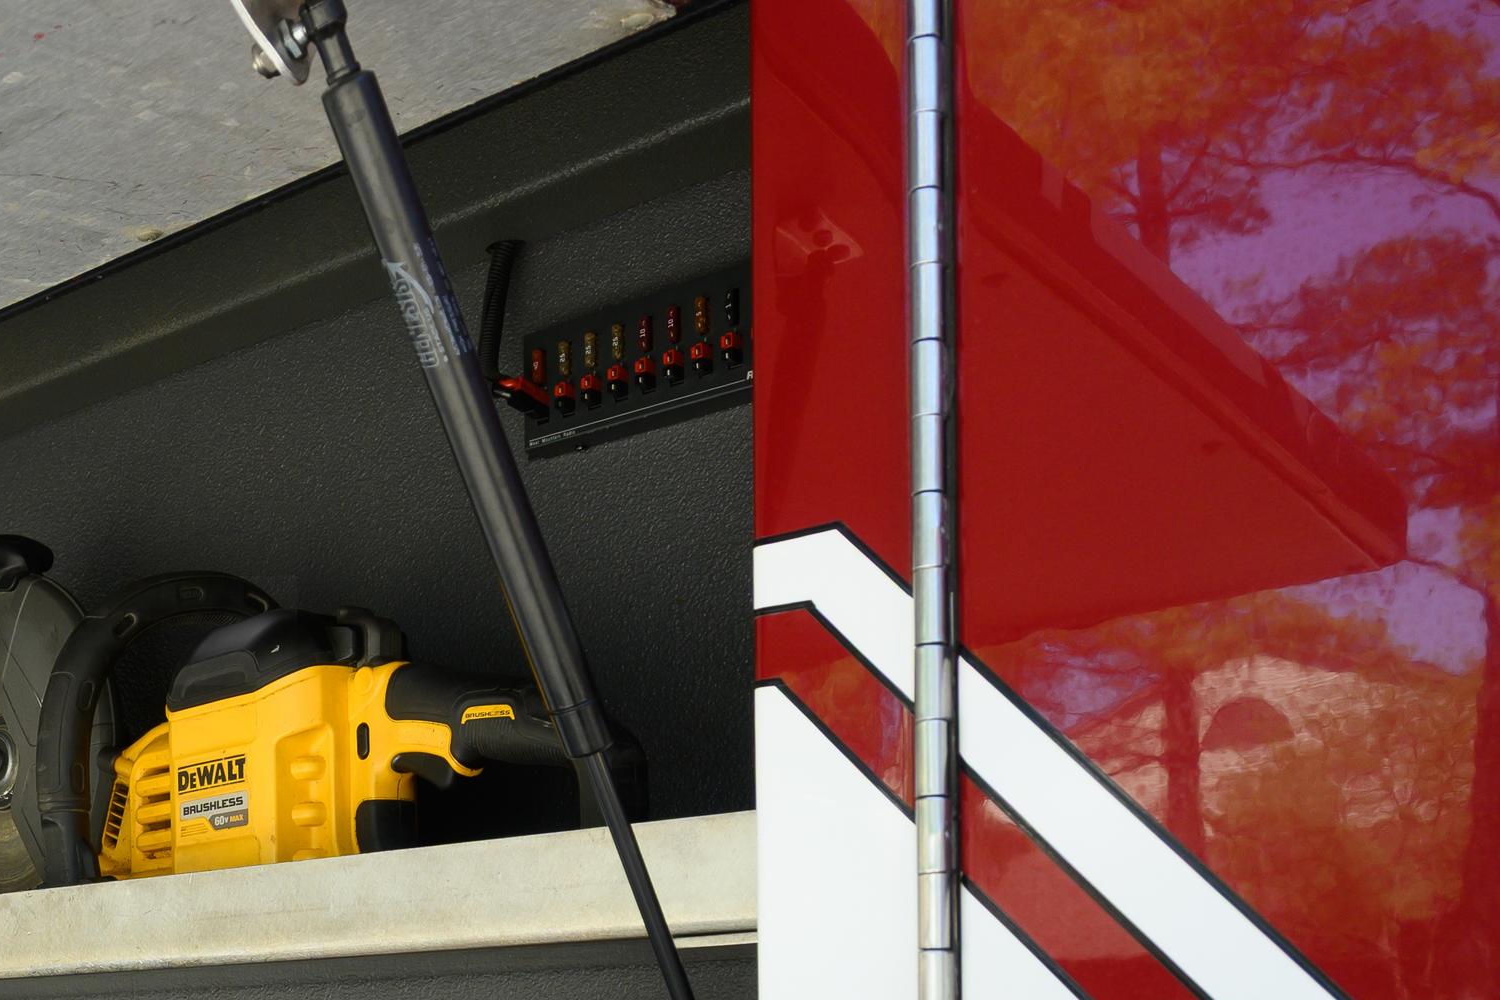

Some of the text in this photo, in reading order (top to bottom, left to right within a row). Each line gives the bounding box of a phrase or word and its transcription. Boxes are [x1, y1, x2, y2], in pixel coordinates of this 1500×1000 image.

[667, 318, 674, 328] 10
[639, 328, 646, 338] 10
[183, 796, 244, 816] BRUSHLESS
[229, 814, 244, 823] MAX
